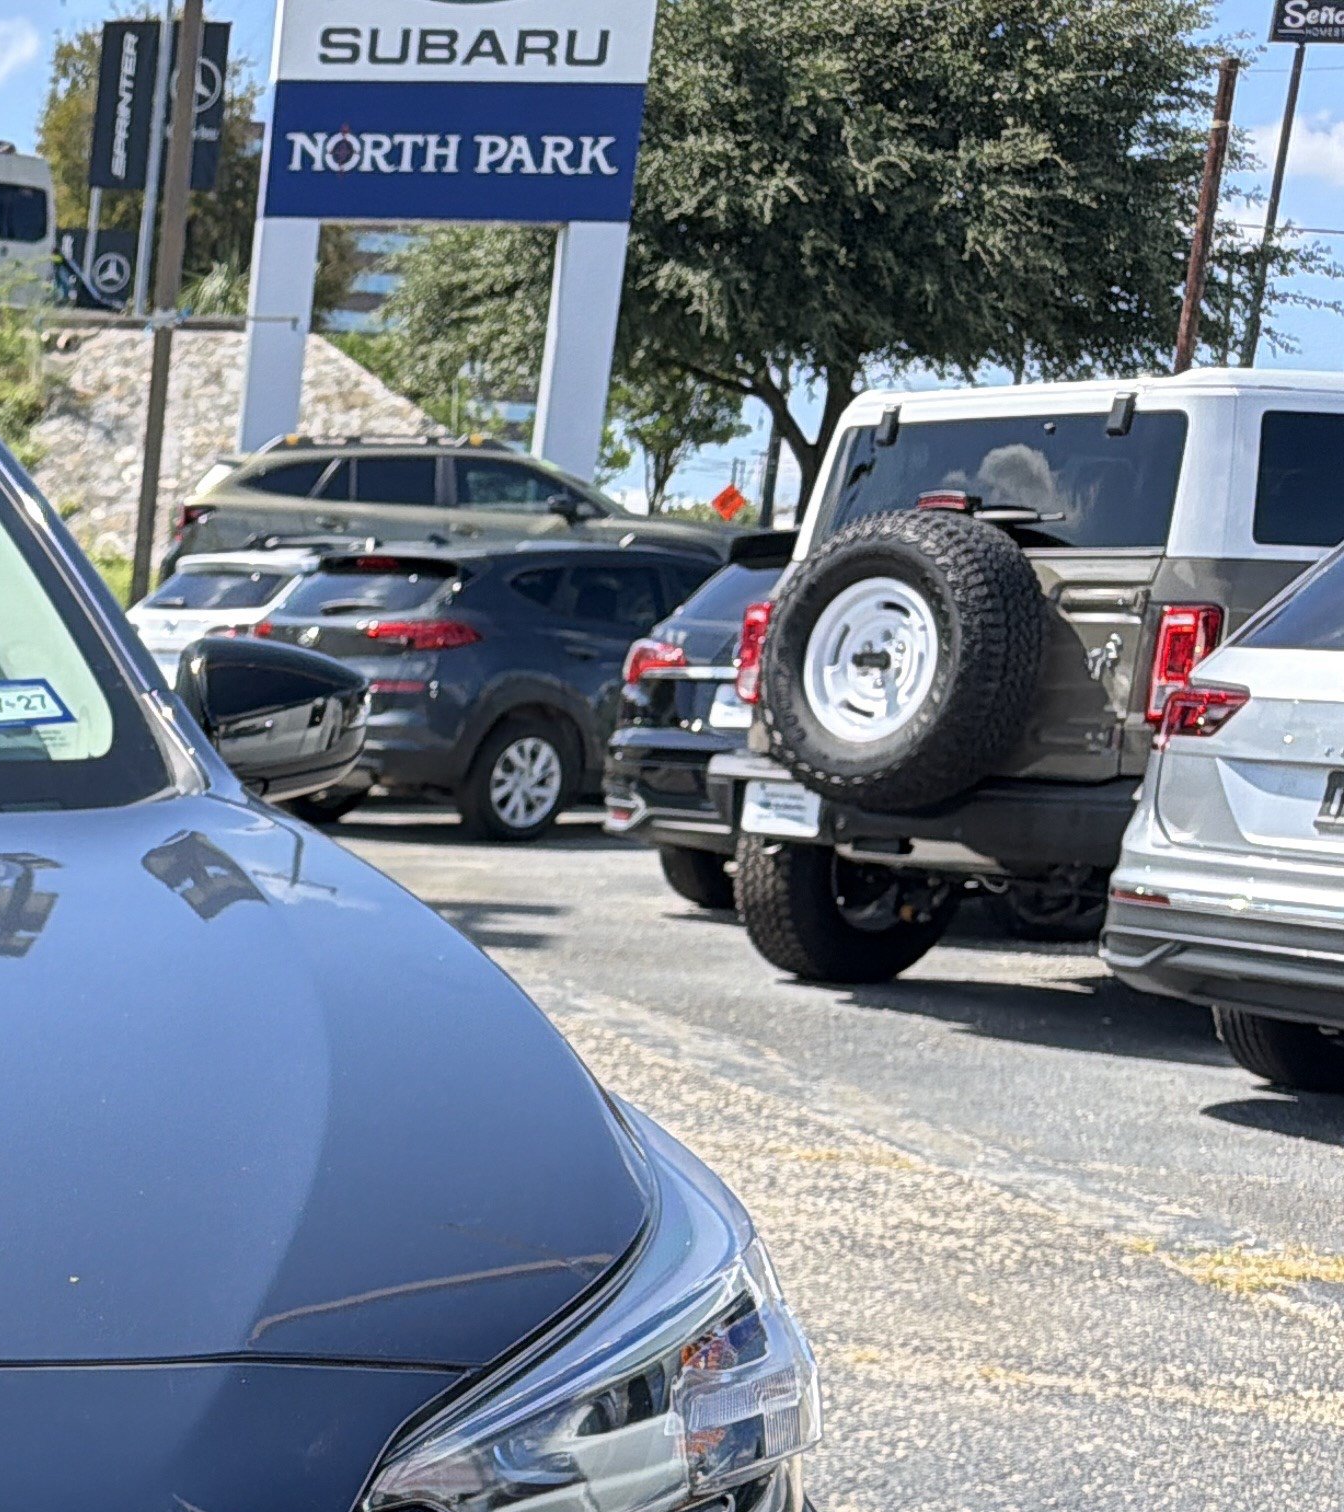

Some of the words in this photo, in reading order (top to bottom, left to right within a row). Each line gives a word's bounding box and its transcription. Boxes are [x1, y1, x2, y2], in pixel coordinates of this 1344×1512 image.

[318, 27, 610, 67] SUBARU
[110, 30, 139, 180] SPRINTER
[286, 130, 462, 174] NORTH
[473, 135, 619, 175] PARK
